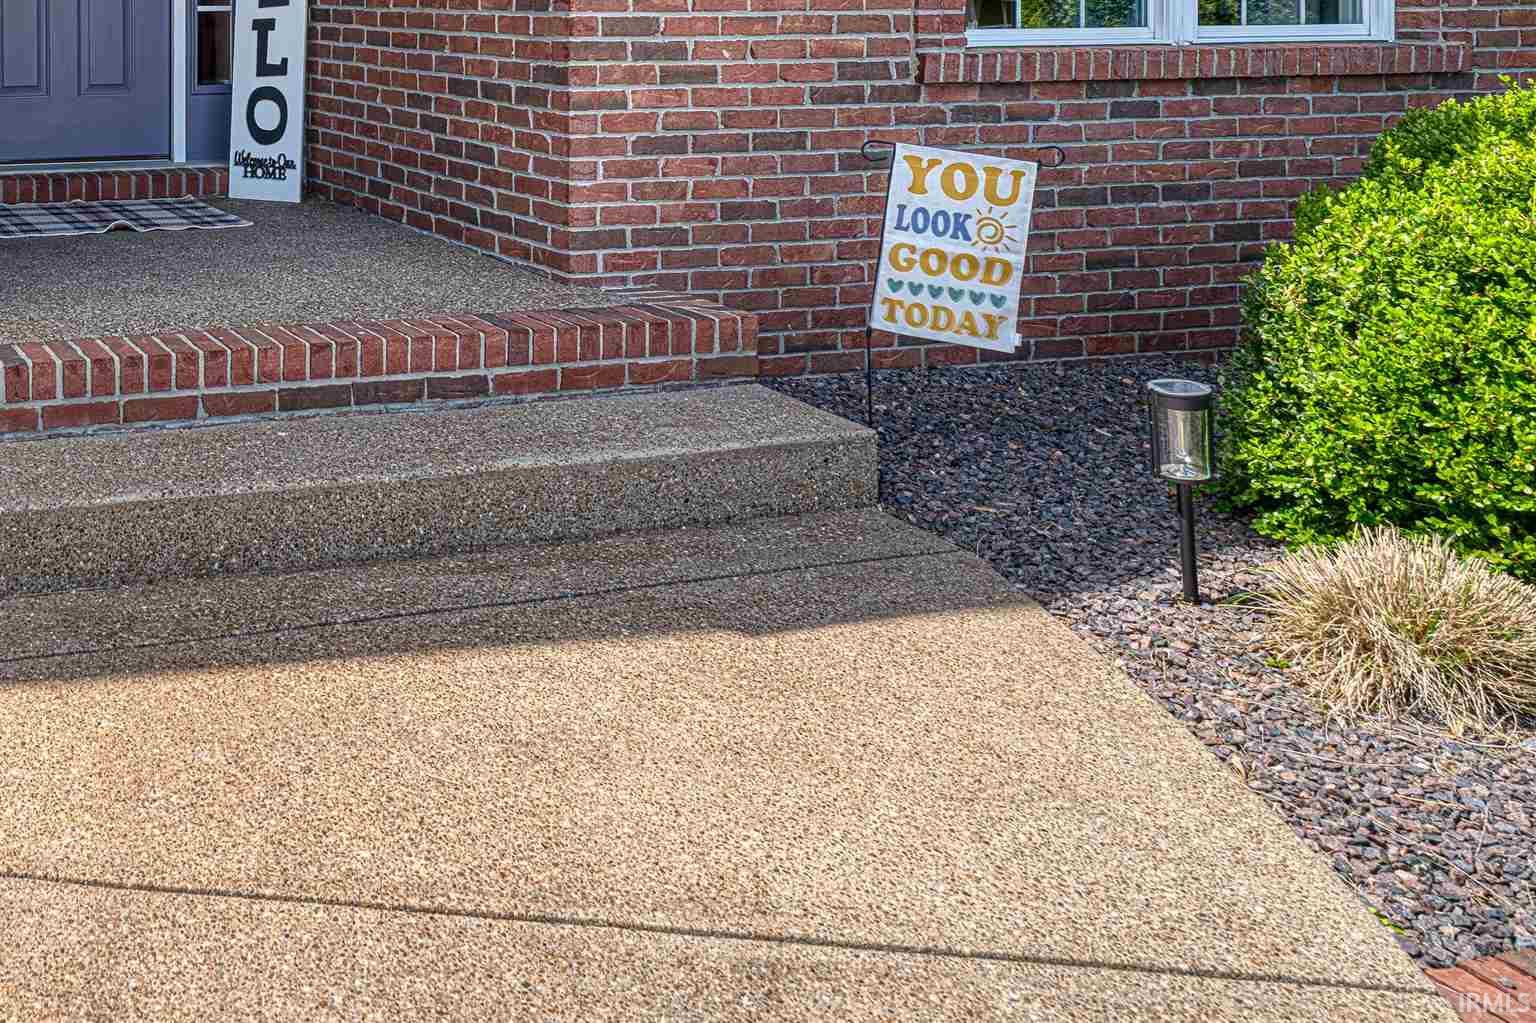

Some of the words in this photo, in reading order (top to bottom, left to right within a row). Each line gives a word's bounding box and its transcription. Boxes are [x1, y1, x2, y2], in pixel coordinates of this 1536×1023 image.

[242, 165, 287, 181] HOME
[902, 154, 1026, 207] YOU
[894, 203, 973, 242] LOOK
[888, 242, 1015, 287] GOOD
[880, 296, 1009, 341] TODAY
